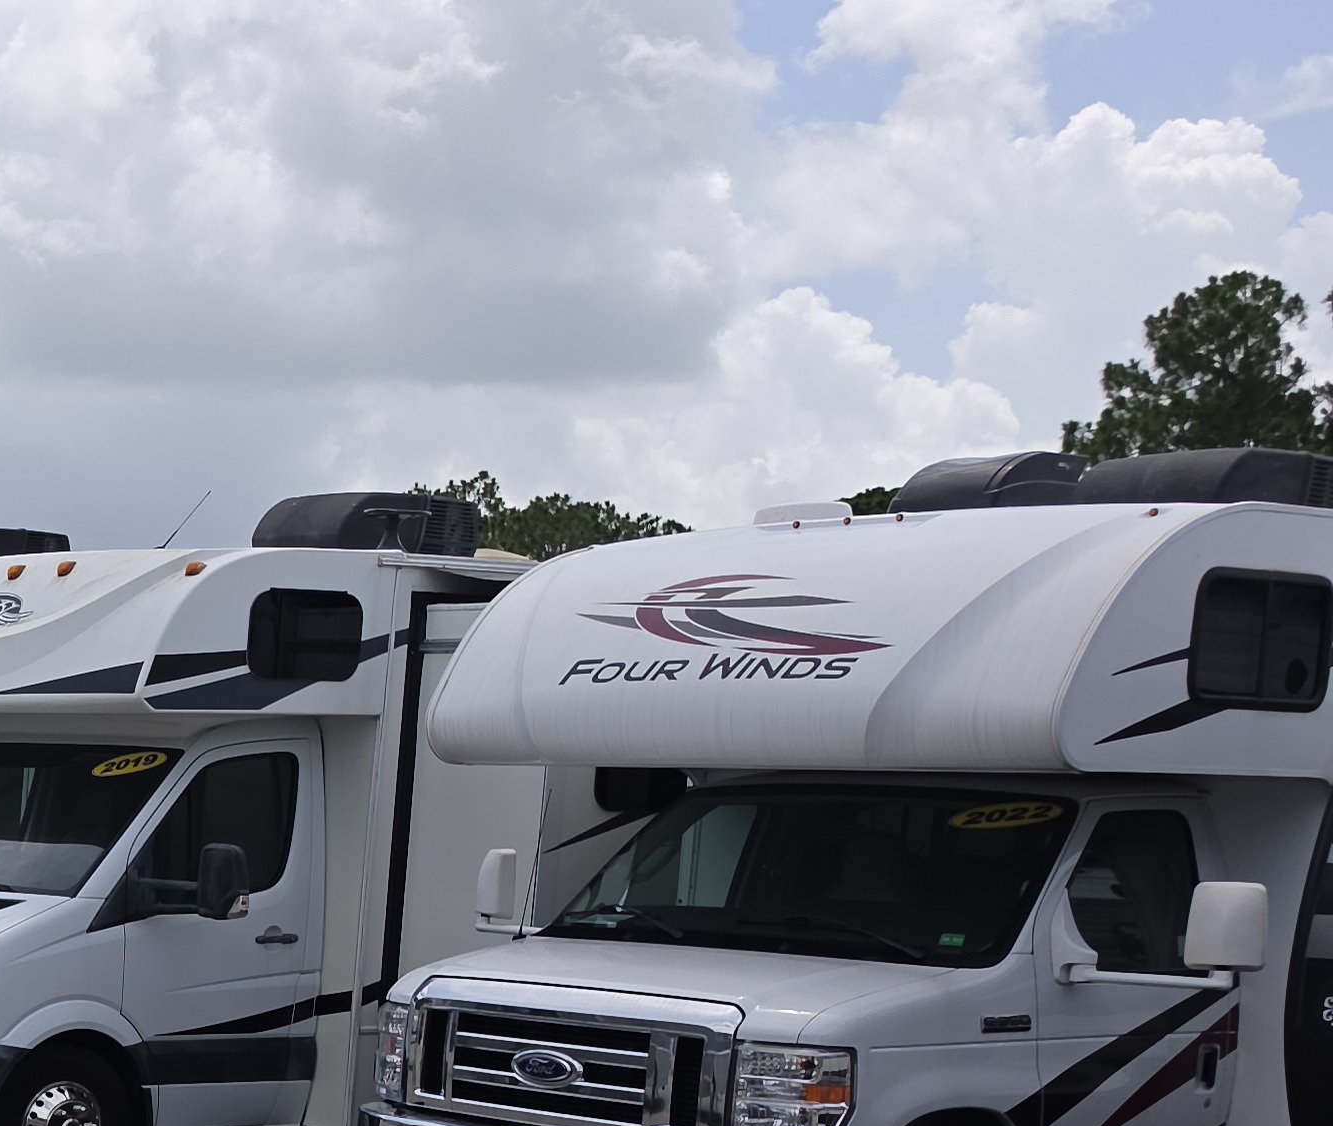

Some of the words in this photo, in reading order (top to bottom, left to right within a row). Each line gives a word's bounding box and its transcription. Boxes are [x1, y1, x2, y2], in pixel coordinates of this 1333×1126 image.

[558, 658, 689, 686] FOUR
[698, 652, 859, 680] WINDS
[100, 753, 159, 774] 2019
[960, 805, 1054, 826] 2022
